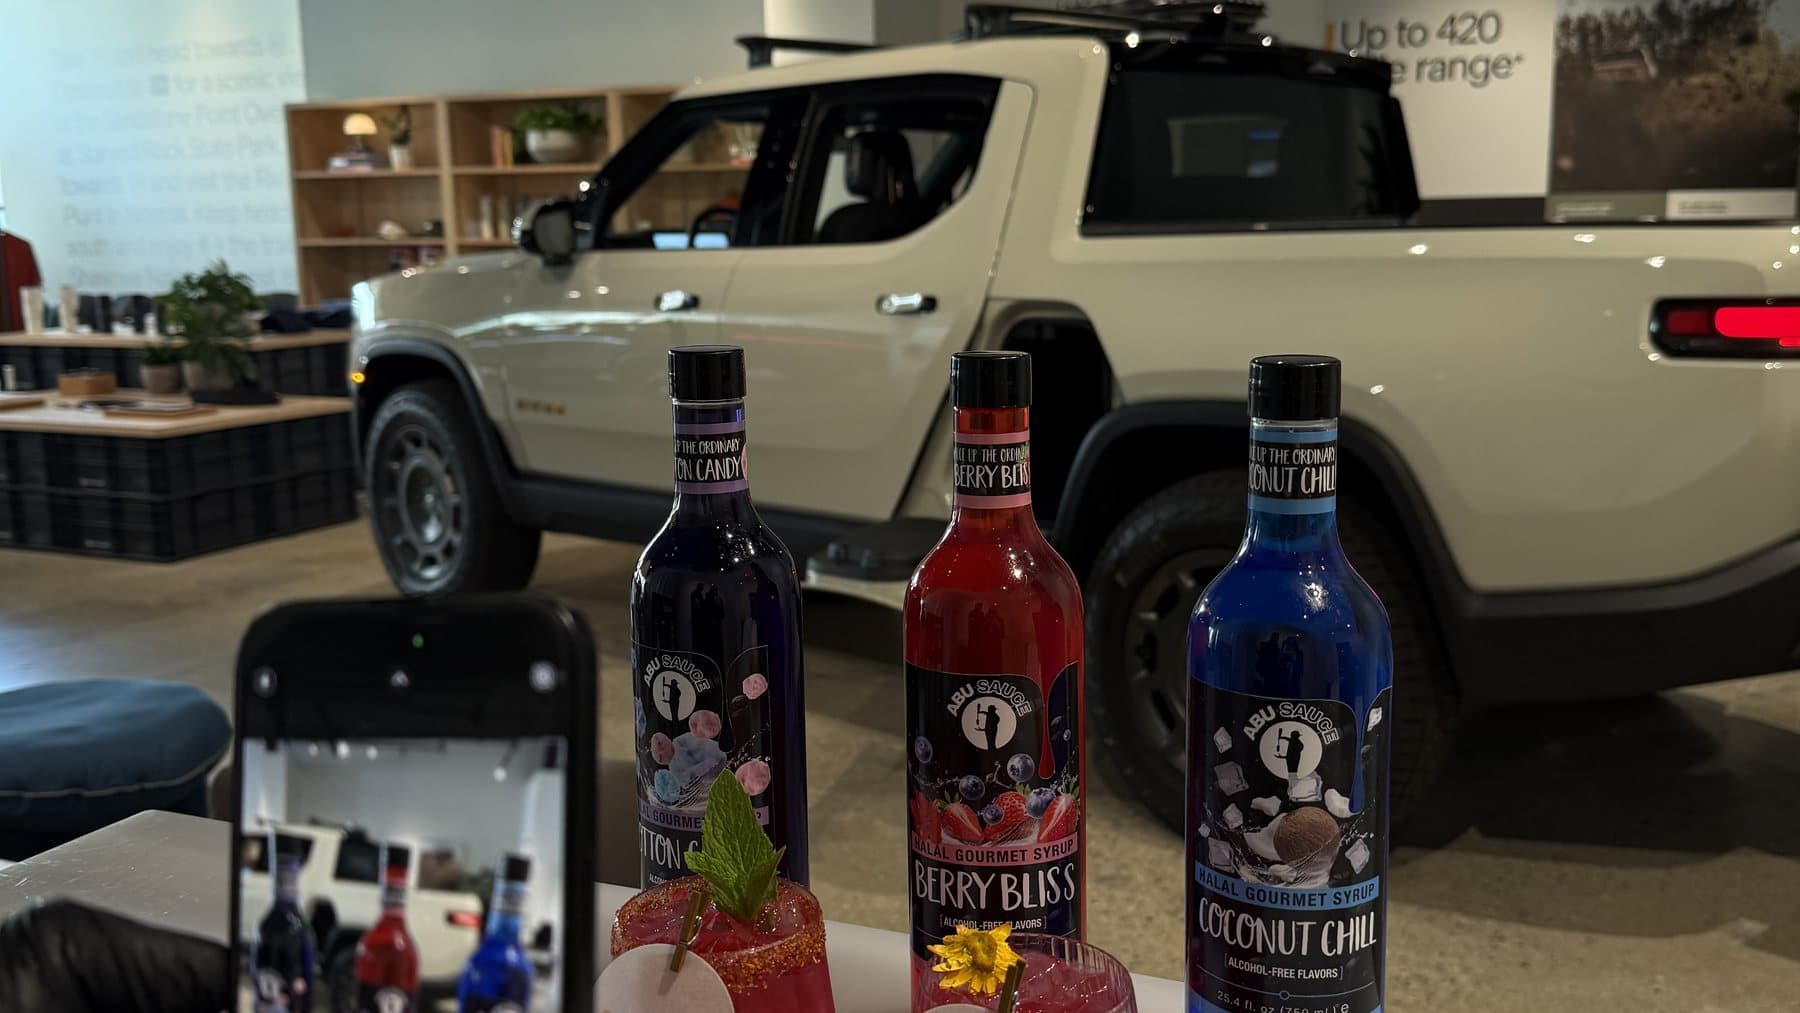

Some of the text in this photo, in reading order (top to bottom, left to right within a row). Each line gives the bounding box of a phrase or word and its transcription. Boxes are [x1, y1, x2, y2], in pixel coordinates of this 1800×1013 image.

[1341, 11, 1502, 54] Up to 420
[682, 440, 697, 454] THE
[698, 438, 741, 455] ORDINARY
[982, 448, 997, 463] THE
[1257, 447, 1267, 462] UP
[1269, 448, 1290, 464] THE
[1293, 446, 1335, 465] ORDINARY
[696, 456, 742, 481] CANDY
[954, 462, 1031, 489] BERRY BLIS
[1300, 465, 1336, 494] CHILL
[643, 654, 711, 692] ABU SAUCE
[947, 679, 1033, 717] ABU SAUCE
[1243, 702, 1339, 744] ABU SAUCE
[653, 810, 705, 829] GOURME
[914, 838, 1074, 863] HALAL GOURMET SYRUP
[915, 859, 1076, 911] BERRY BLISS
[1199, 869, 1376, 907] HALAL GOURMET SYRUP
[1199, 897, 1377, 958] COCONUT CHILL
[1216, 990, 1240, 1007] 25.4
